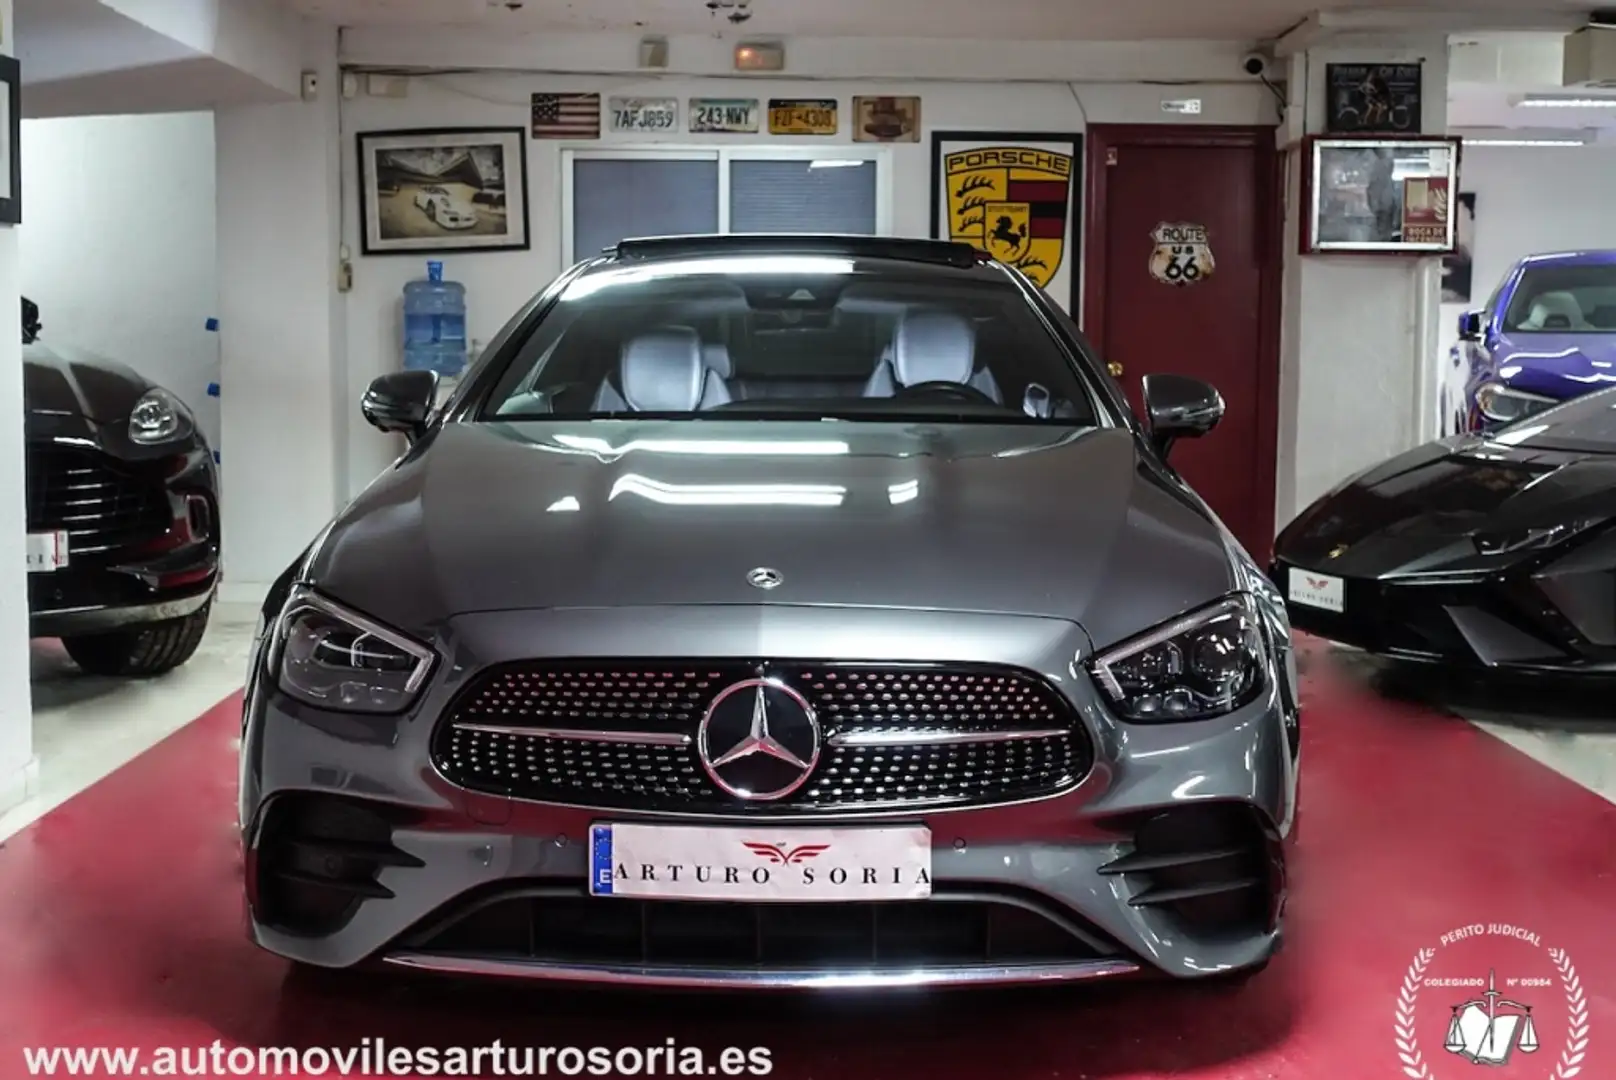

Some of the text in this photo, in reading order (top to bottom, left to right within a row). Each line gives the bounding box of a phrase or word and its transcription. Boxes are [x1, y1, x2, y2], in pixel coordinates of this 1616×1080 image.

[949, 151, 1069, 171] PORSCHE
[1162, 228, 1205, 240] ROUTE
[1165, 255, 1200, 279] 66
[599, 869, 612, 884] E
[613, 863, 932, 885] ARTURO SORIA
